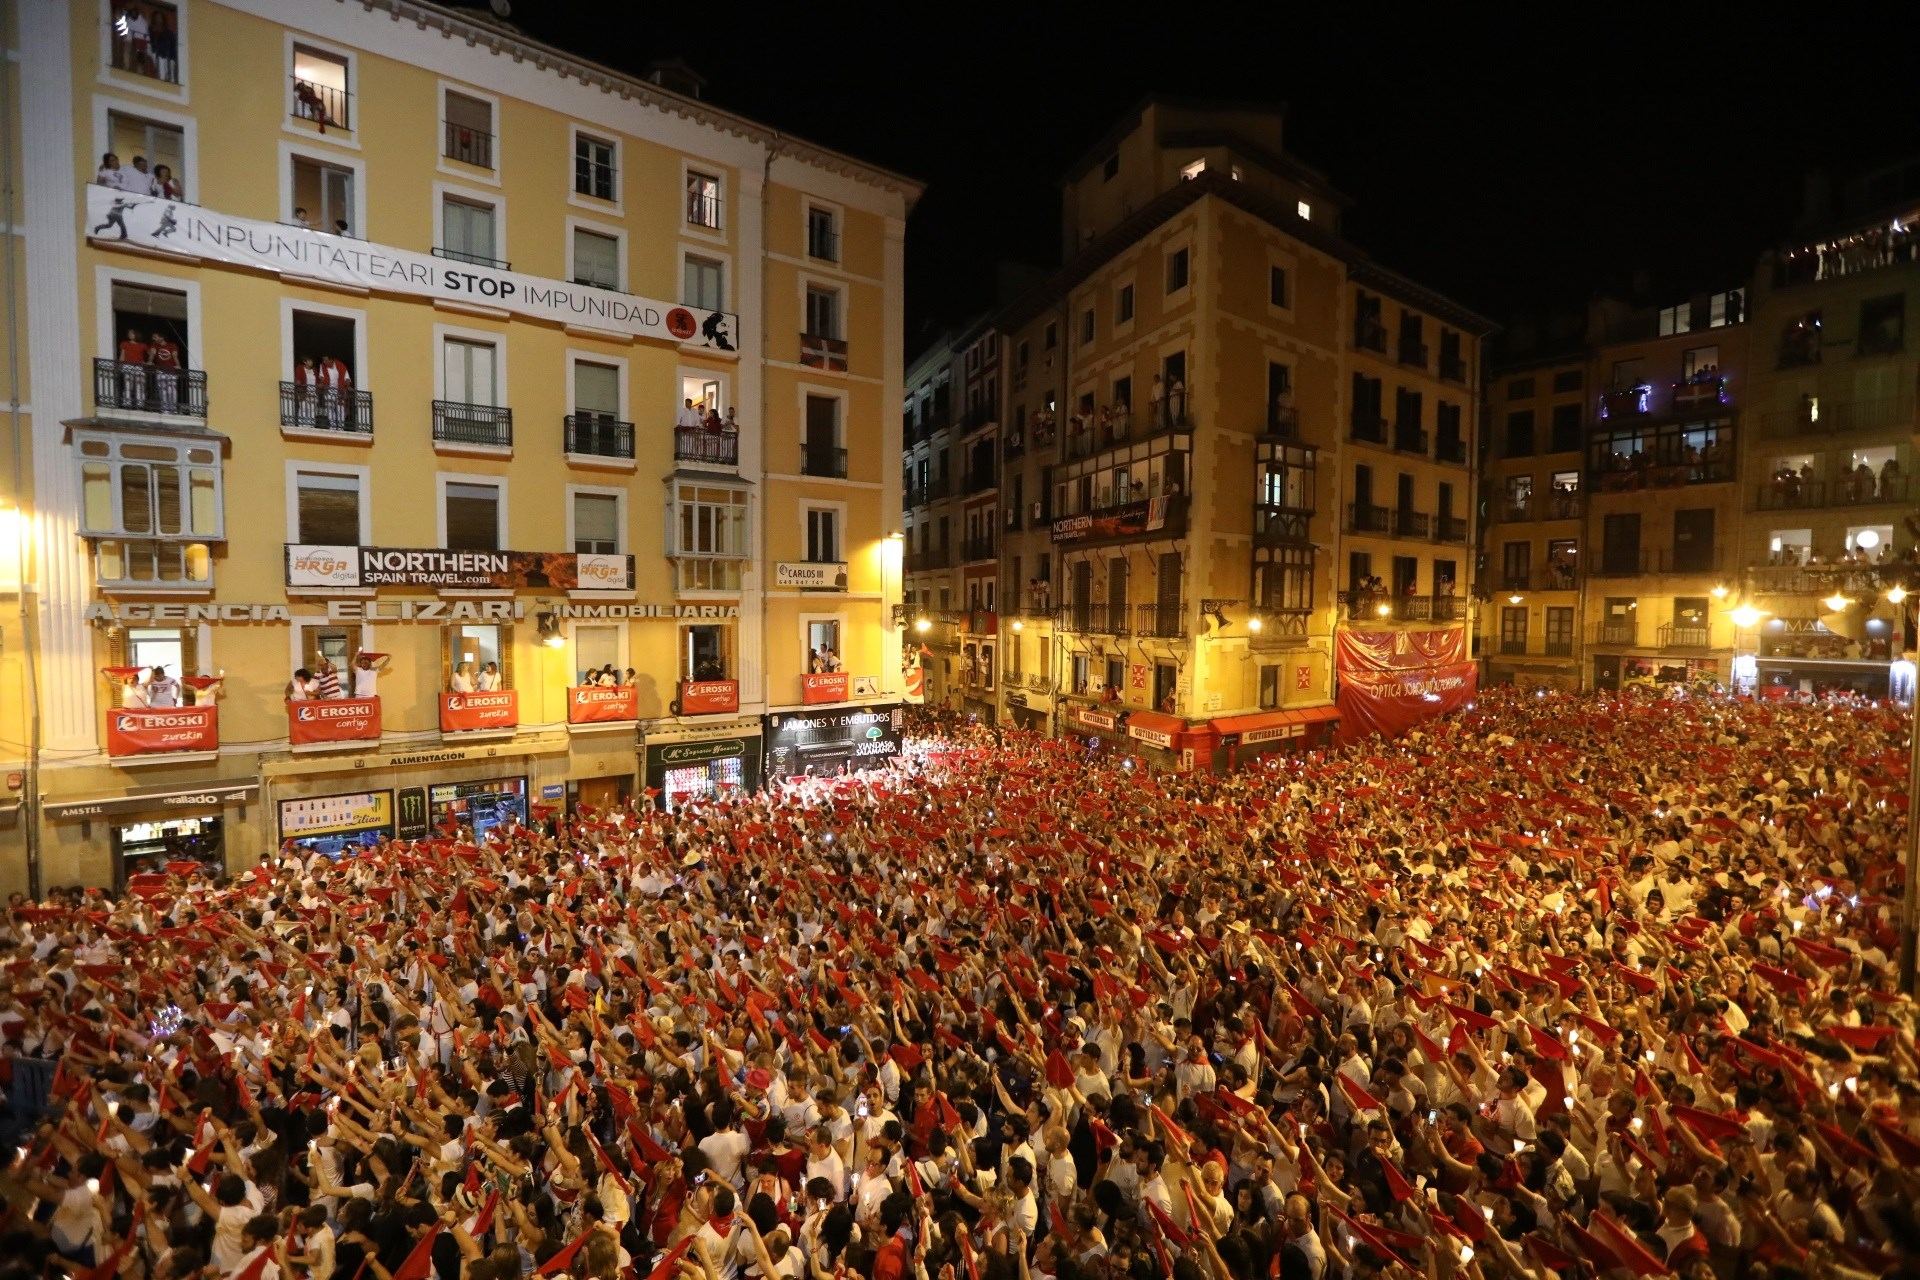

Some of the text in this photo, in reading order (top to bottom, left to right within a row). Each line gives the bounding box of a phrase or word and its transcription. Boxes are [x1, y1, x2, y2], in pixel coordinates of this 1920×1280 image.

[187, 217, 660, 327] INPUNITATEARI STOP IMPUNIDAD
[1053, 516, 1093, 533] NORTHERN
[295, 560, 347, 576] ARGA
[363, 552, 508, 572] NORTHERN
[364, 572, 490, 584] SPAIN TRAVEL.com
[788, 570, 816, 578] CARLOS
[84, 601, 741, 621] AGENCIA ELIZARI INMOBILIARIA
[819, 677, 846, 686] EROSKI
[700, 684, 732, 695] EROSKI
[466, 697, 509, 707] EROSKI
[592, 691, 630, 701] EROSKI
[320, 706, 371, 718] EROSKI
[144, 716, 204, 728] EROSKI
[335, 718, 369, 730] contigo
[782, 718, 827, 731] JAMONES
[830, 717, 838, 727] Y
[841, 713, 890, 726] EMBUTIDOS
[161, 730, 204, 742] zurekin
[856, 746, 897, 757] SALAMANCA
[858, 742, 888, 750] VIANDAS
[61, 806, 103, 816] AMSTEL
